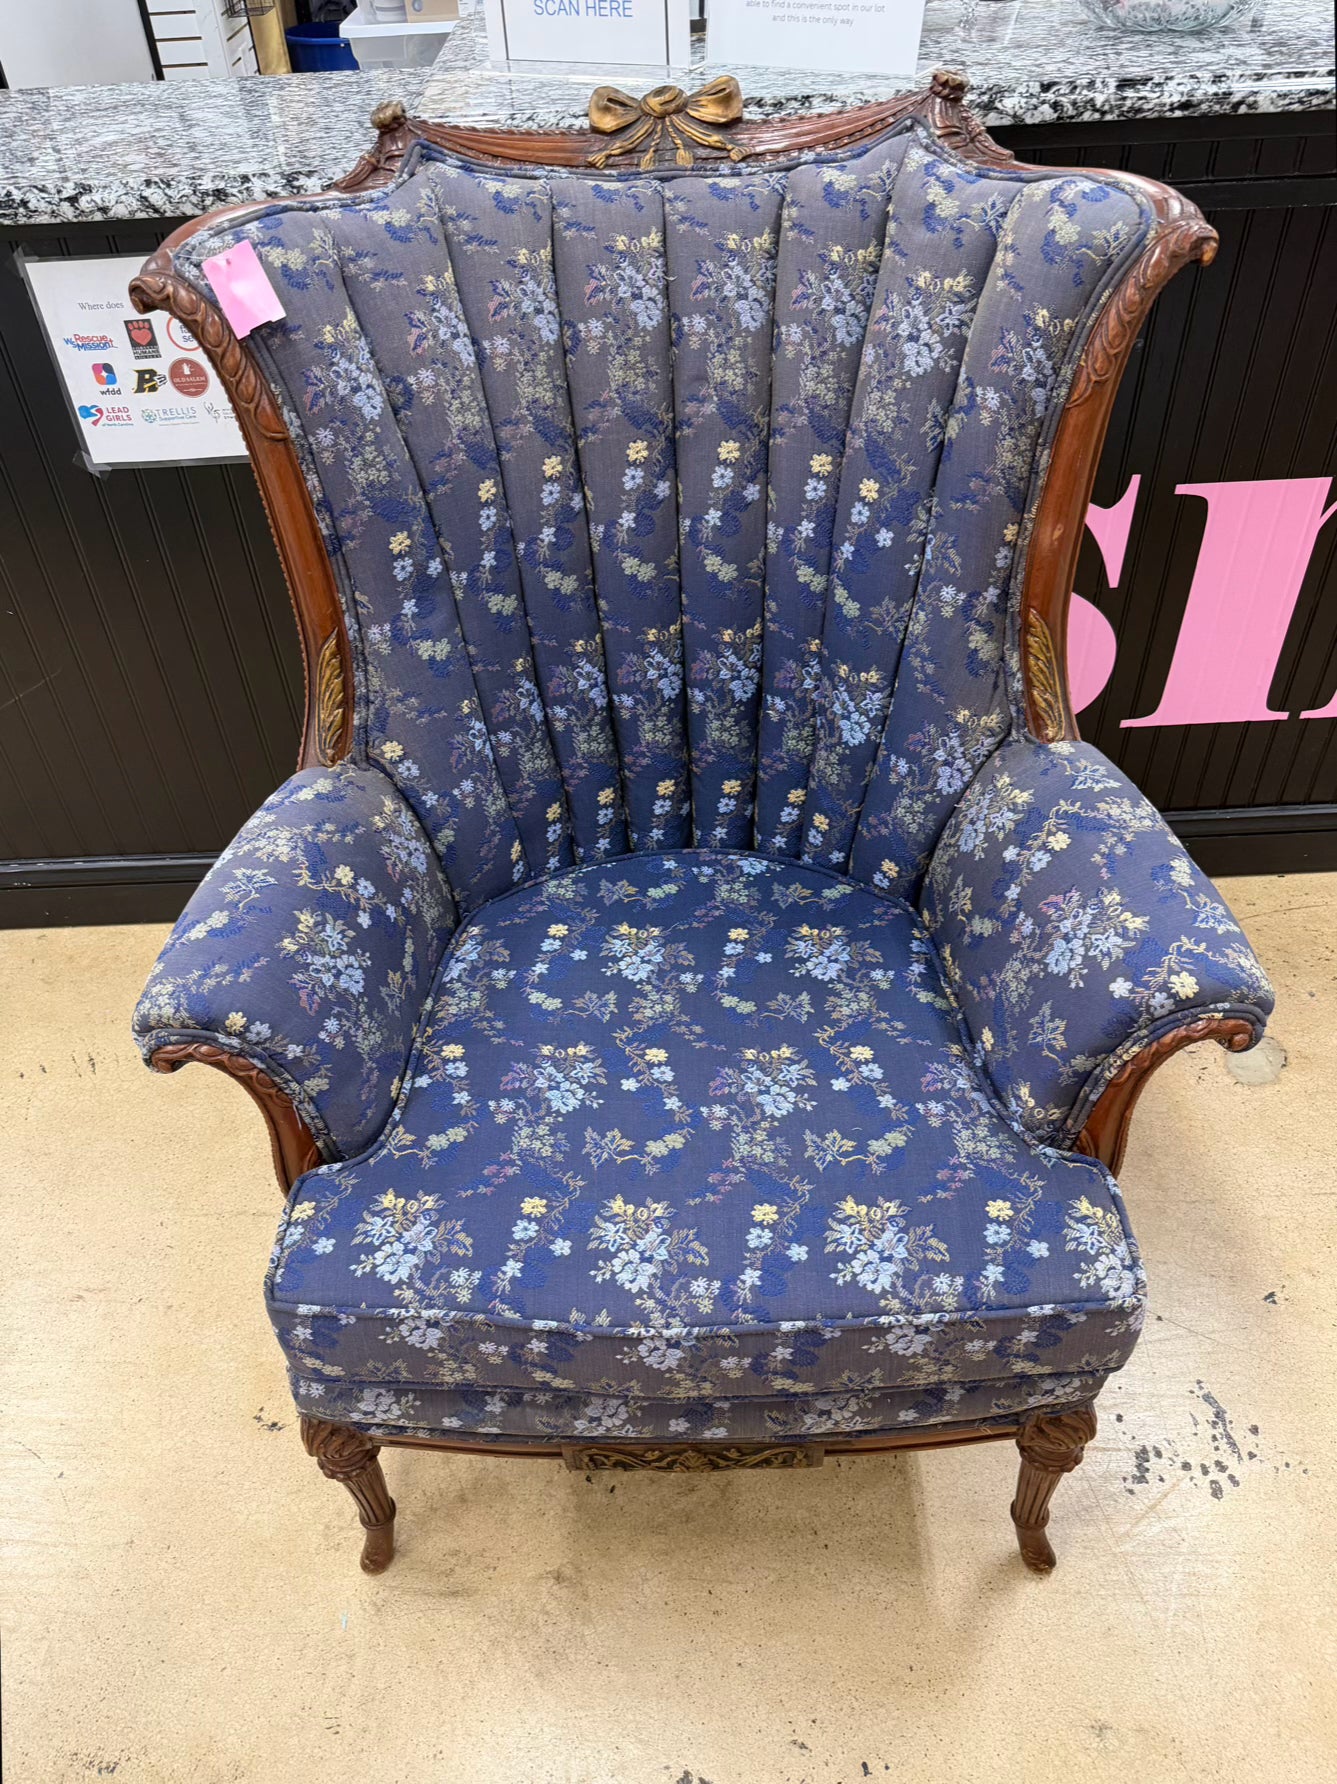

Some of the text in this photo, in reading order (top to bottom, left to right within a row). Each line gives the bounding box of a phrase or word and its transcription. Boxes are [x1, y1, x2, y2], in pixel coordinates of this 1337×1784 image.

[534, 0, 633, 18] SCAN HERE
[762, 0, 769, 8] to
[771, 0, 785, 9] find
[792, 2, 832, 10] convenient
[833, 3, 850, 12] spot
[851, 3, 859, 11] in
[874, 4, 885, 13] lot
[772, 14, 786, 22] and
[787, 14, 800, 23] this
[809, 15, 821, 24] the
[822, 17, 838, 26] only
[77, 301, 125, 311] Where does
[73, 333, 109, 343] Rescue
[77, 341, 111, 351] Mission
[99, 387, 122, 396] wfdd
[105, 406, 130, 414] LEAD
[155, 406, 197, 417] TRELLIS
[105, 414, 133, 422] GIRLS
